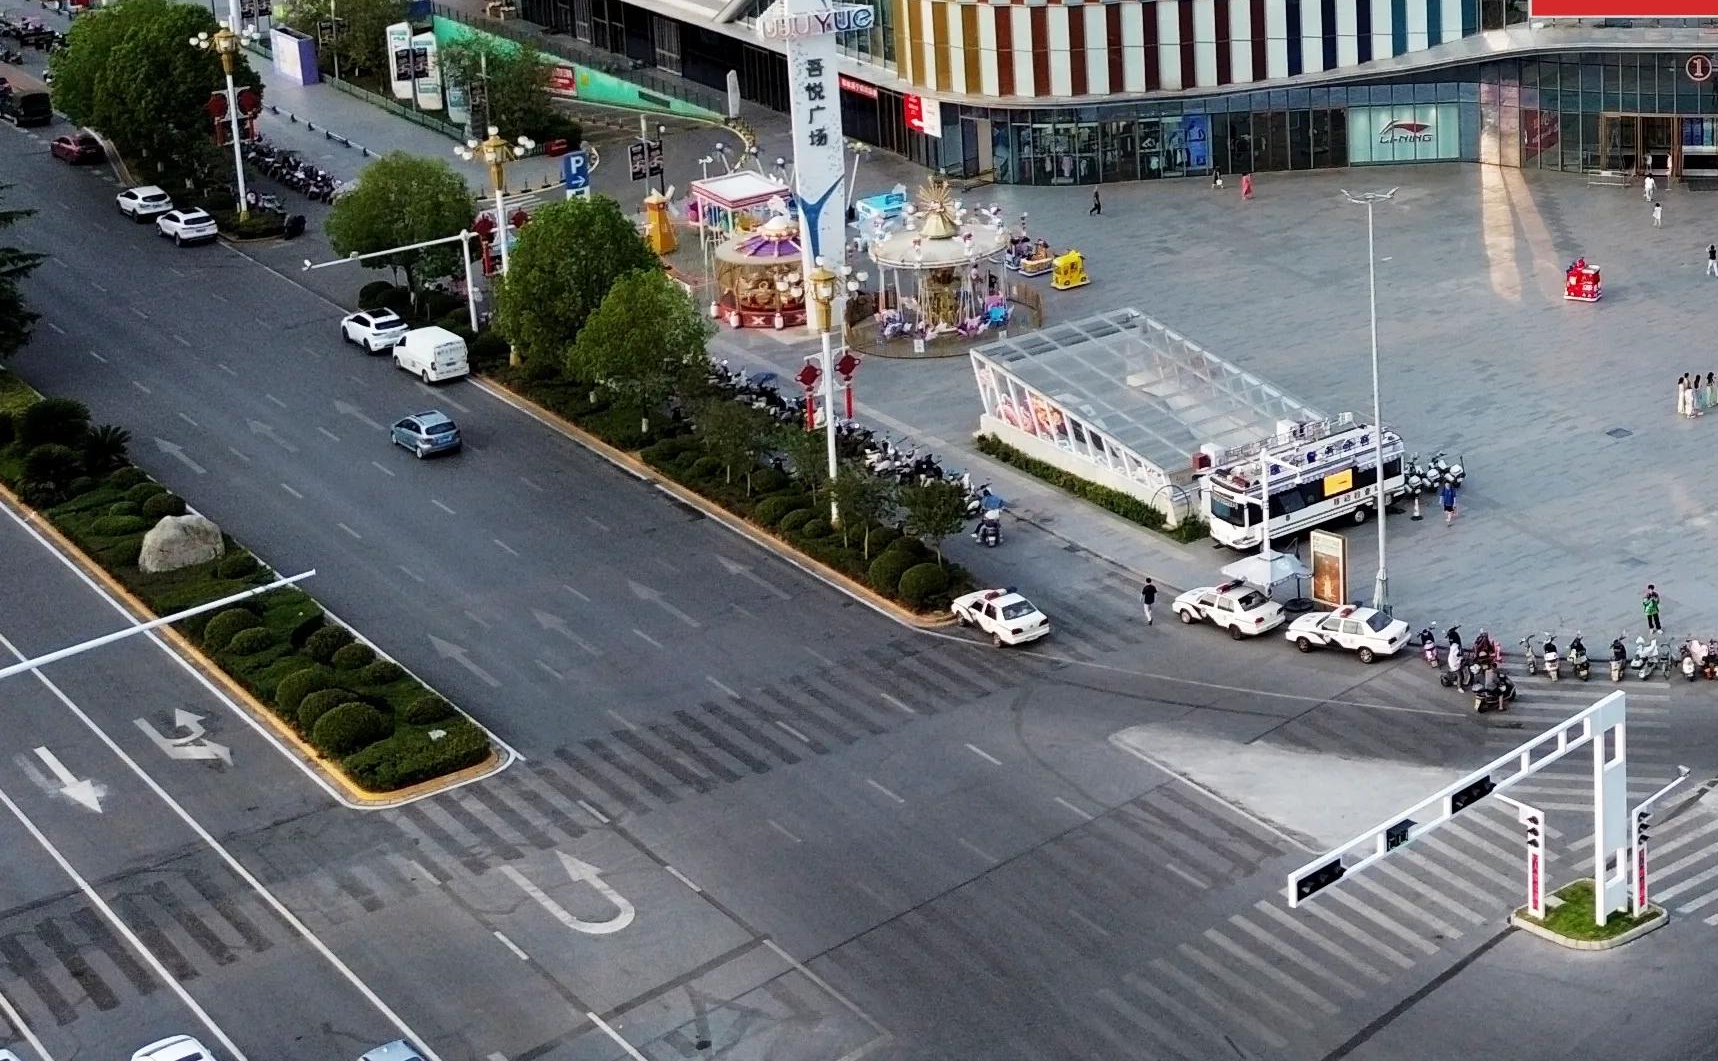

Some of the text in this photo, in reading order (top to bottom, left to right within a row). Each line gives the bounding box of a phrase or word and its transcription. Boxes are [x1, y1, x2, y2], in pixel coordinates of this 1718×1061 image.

[804, 58, 828, 147] 吾悦广场
[570, 155, 585, 174] P
